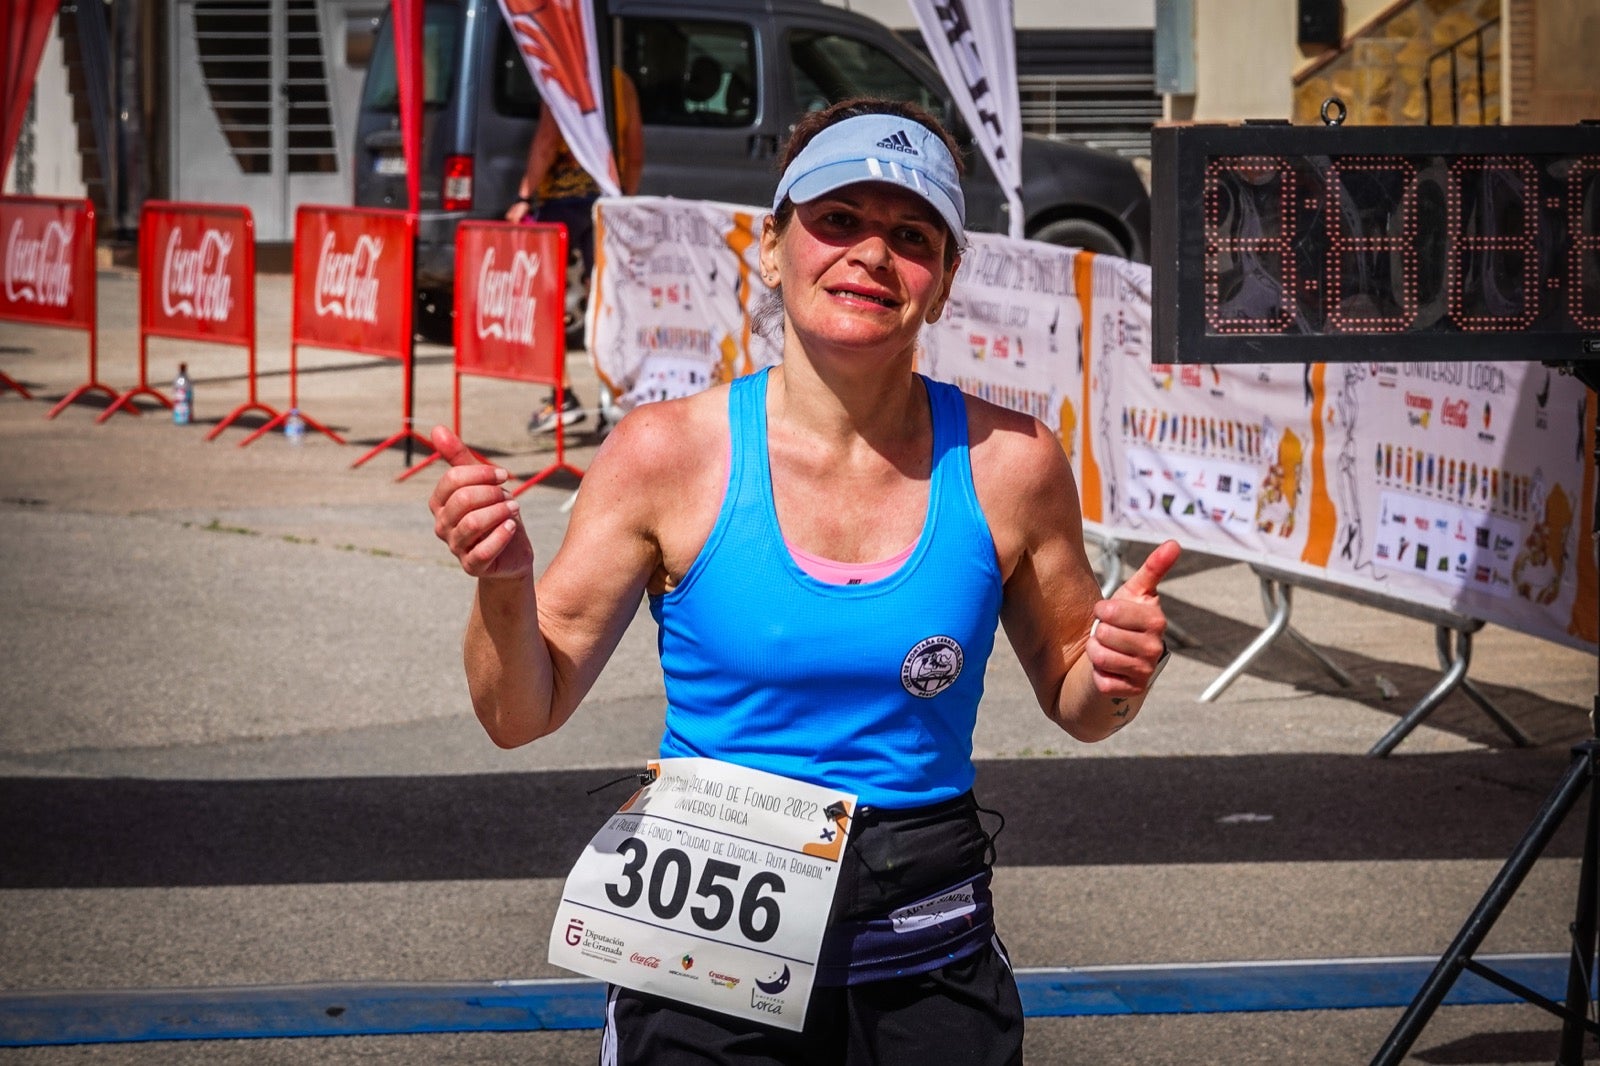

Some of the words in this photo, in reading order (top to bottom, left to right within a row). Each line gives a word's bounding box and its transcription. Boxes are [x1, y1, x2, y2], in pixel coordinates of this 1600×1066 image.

[876, 141, 919, 156] adidas
[674, 798, 717, 818] UNIVERSO
[718, 803, 748, 827] LORCA
[726, 785, 741, 803] DE
[744, 786, 781, 813] FONDO
[784, 796, 818, 822] 2022
[712, 840, 725, 857] DE
[765, 851, 787, 872] RUTA
[604, 837, 786, 943] 3056
[582, 940, 591, 948] de
[592, 941, 623, 956] Granada
[584, 929, 625, 947] Diputación
[751, 987, 783, 1015] Lorca
